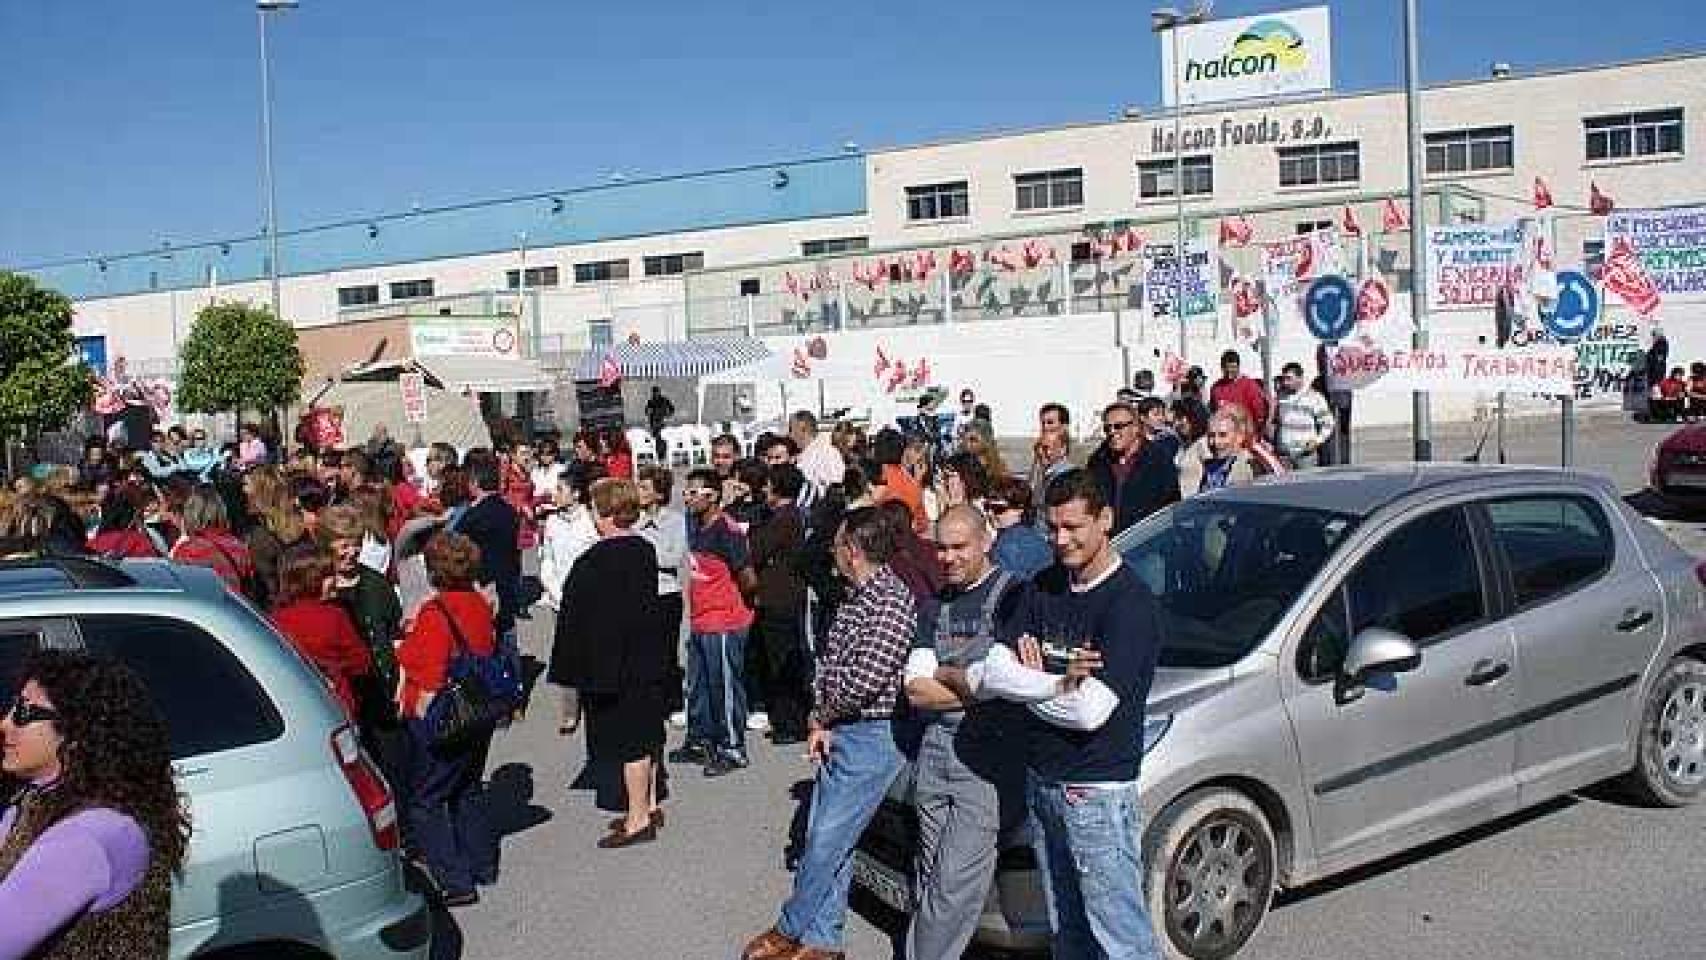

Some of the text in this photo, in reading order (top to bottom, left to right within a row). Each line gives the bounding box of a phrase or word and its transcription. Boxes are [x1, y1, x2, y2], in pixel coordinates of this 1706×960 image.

[1185, 53, 1278, 81] halcon
[1152, 126, 1217, 152] Hacon
[1332, 350, 1448, 376] QUEREMOS
